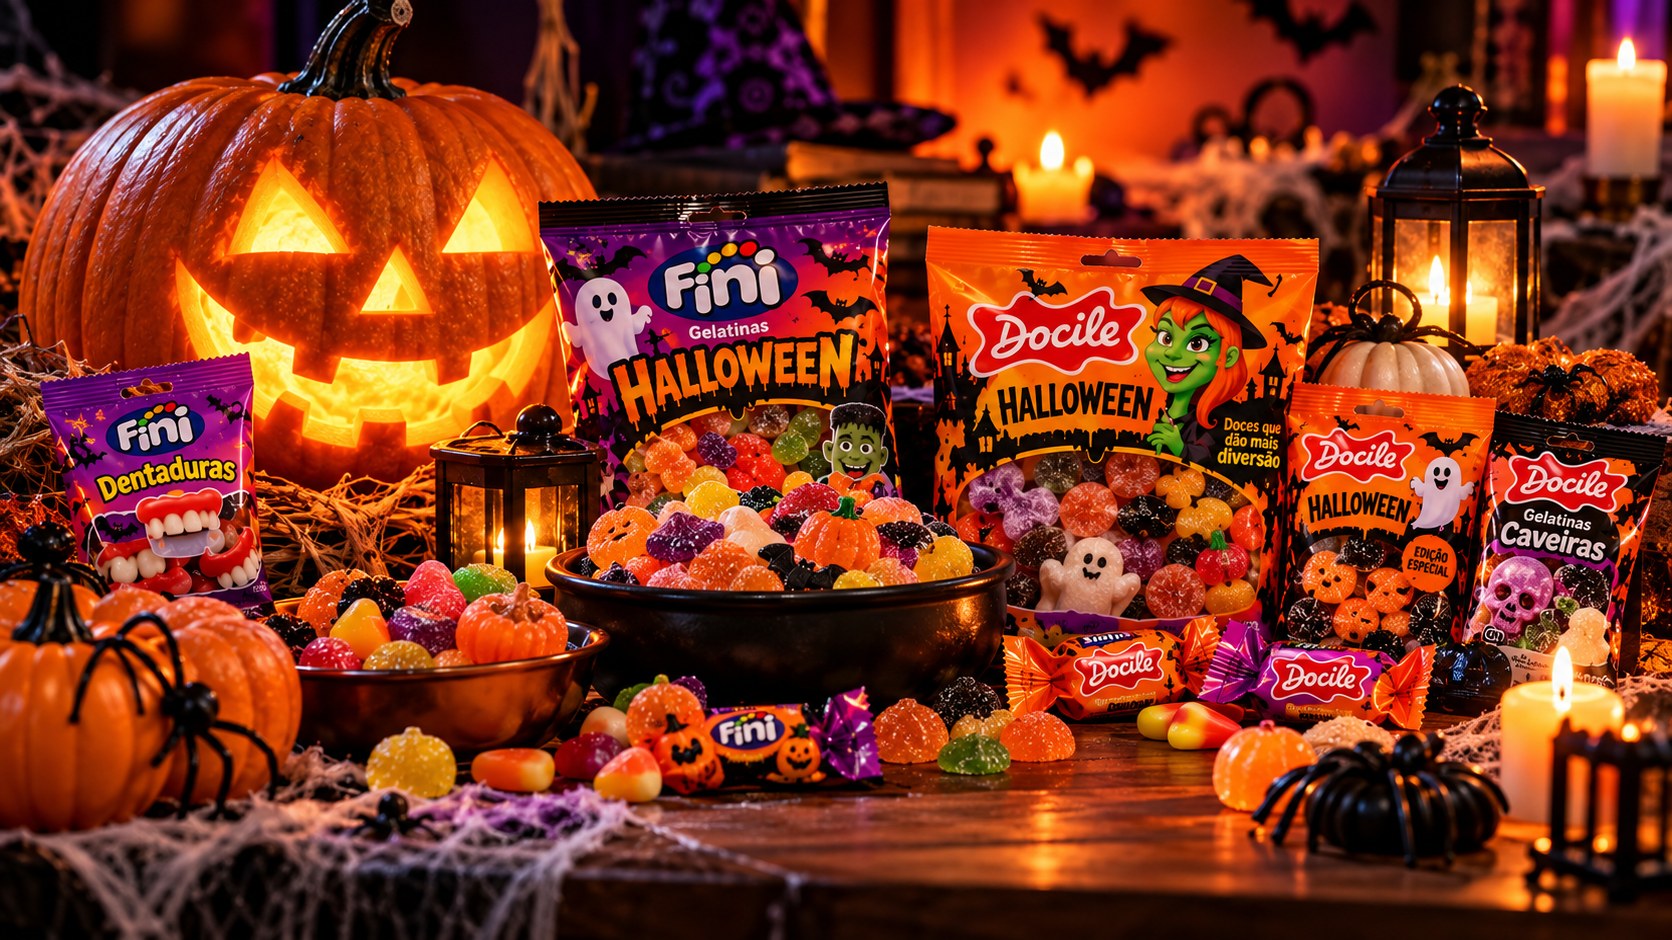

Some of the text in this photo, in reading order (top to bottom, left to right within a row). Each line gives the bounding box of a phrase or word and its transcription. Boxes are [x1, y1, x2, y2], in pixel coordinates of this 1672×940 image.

[665, 250, 780, 314] Fini
[688, 321, 769, 340] Gelatinas
[991, 306, 1120, 359] Docile
[613, 333, 854, 425] HALLOWEEN
[997, 381, 1154, 426] HALLOWEEN
[117, 405, 194, 451] Fini
[1224, 417, 1281, 435] Doces que
[1225, 434, 1279, 450] dão mais
[1217, 448, 1281, 469] diversão
[1314, 440, 1396, 470] Docile
[97, 456, 236, 502] Dentaduras
[1520, 465, 1608, 498] Docile
[1308, 491, 1412, 524] HALLOWEEN
[1523, 508, 1592, 532] Gelatinas
[1413, 546, 1449, 564] EDIÇÃO
[1500, 521, 1607, 561] Caveiras
[1407, 558, 1449, 578] ESPECIAL
[1088, 650, 1154, 687] Docile
[1281, 664, 1356, 691] Docile
[718, 714, 777, 746] Fini
